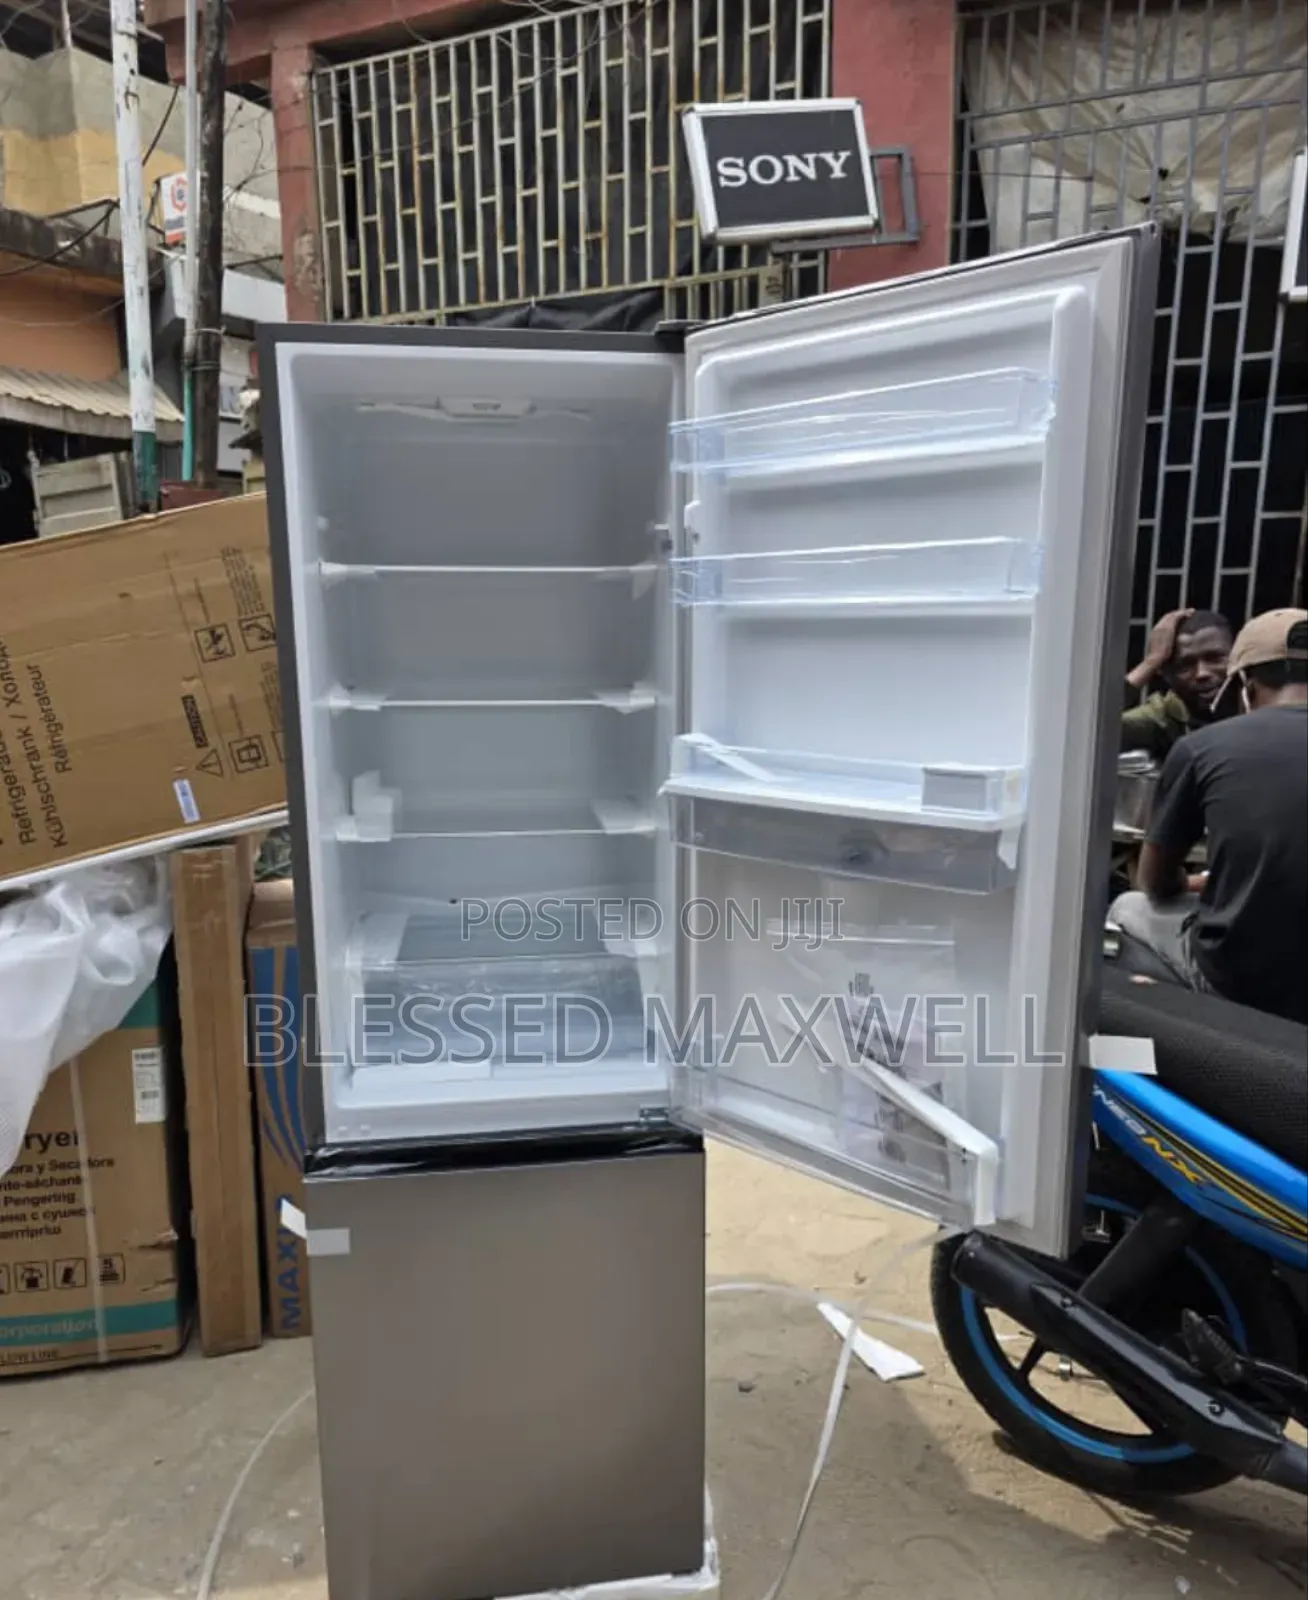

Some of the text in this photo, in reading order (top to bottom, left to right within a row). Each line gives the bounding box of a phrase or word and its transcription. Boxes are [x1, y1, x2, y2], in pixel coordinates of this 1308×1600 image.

[716, 151, 852, 188] SONY
[0, 730, 37, 845] Refrigera
[276, 1194, 302, 1328] MAXI
